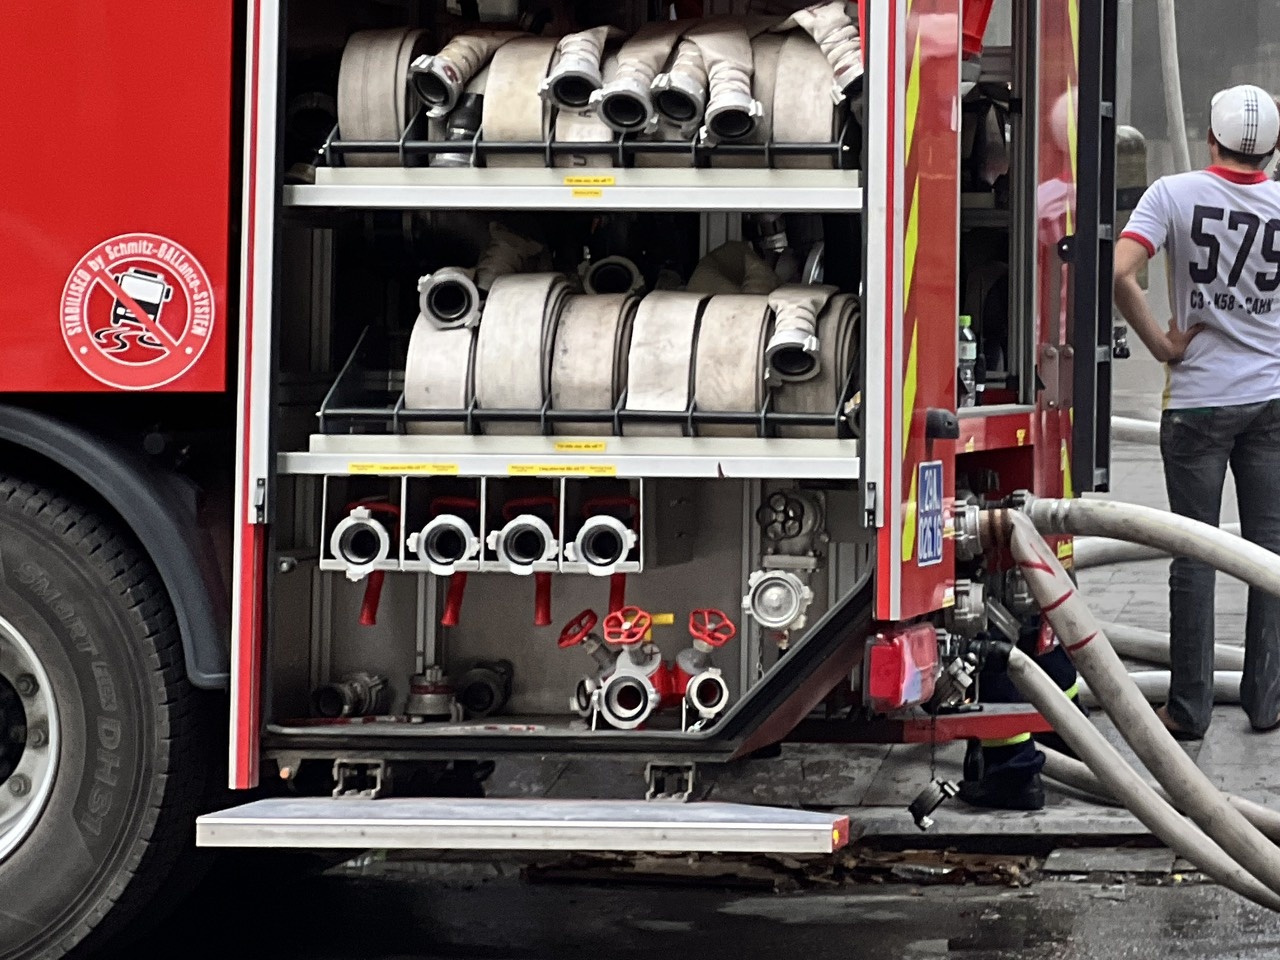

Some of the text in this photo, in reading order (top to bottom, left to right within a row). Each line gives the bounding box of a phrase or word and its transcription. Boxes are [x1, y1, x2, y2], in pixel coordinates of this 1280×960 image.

[87, 255, 105, 272] by
[1190, 289, 1204, 310] C3
[1213, 292, 1236, 311] K58
